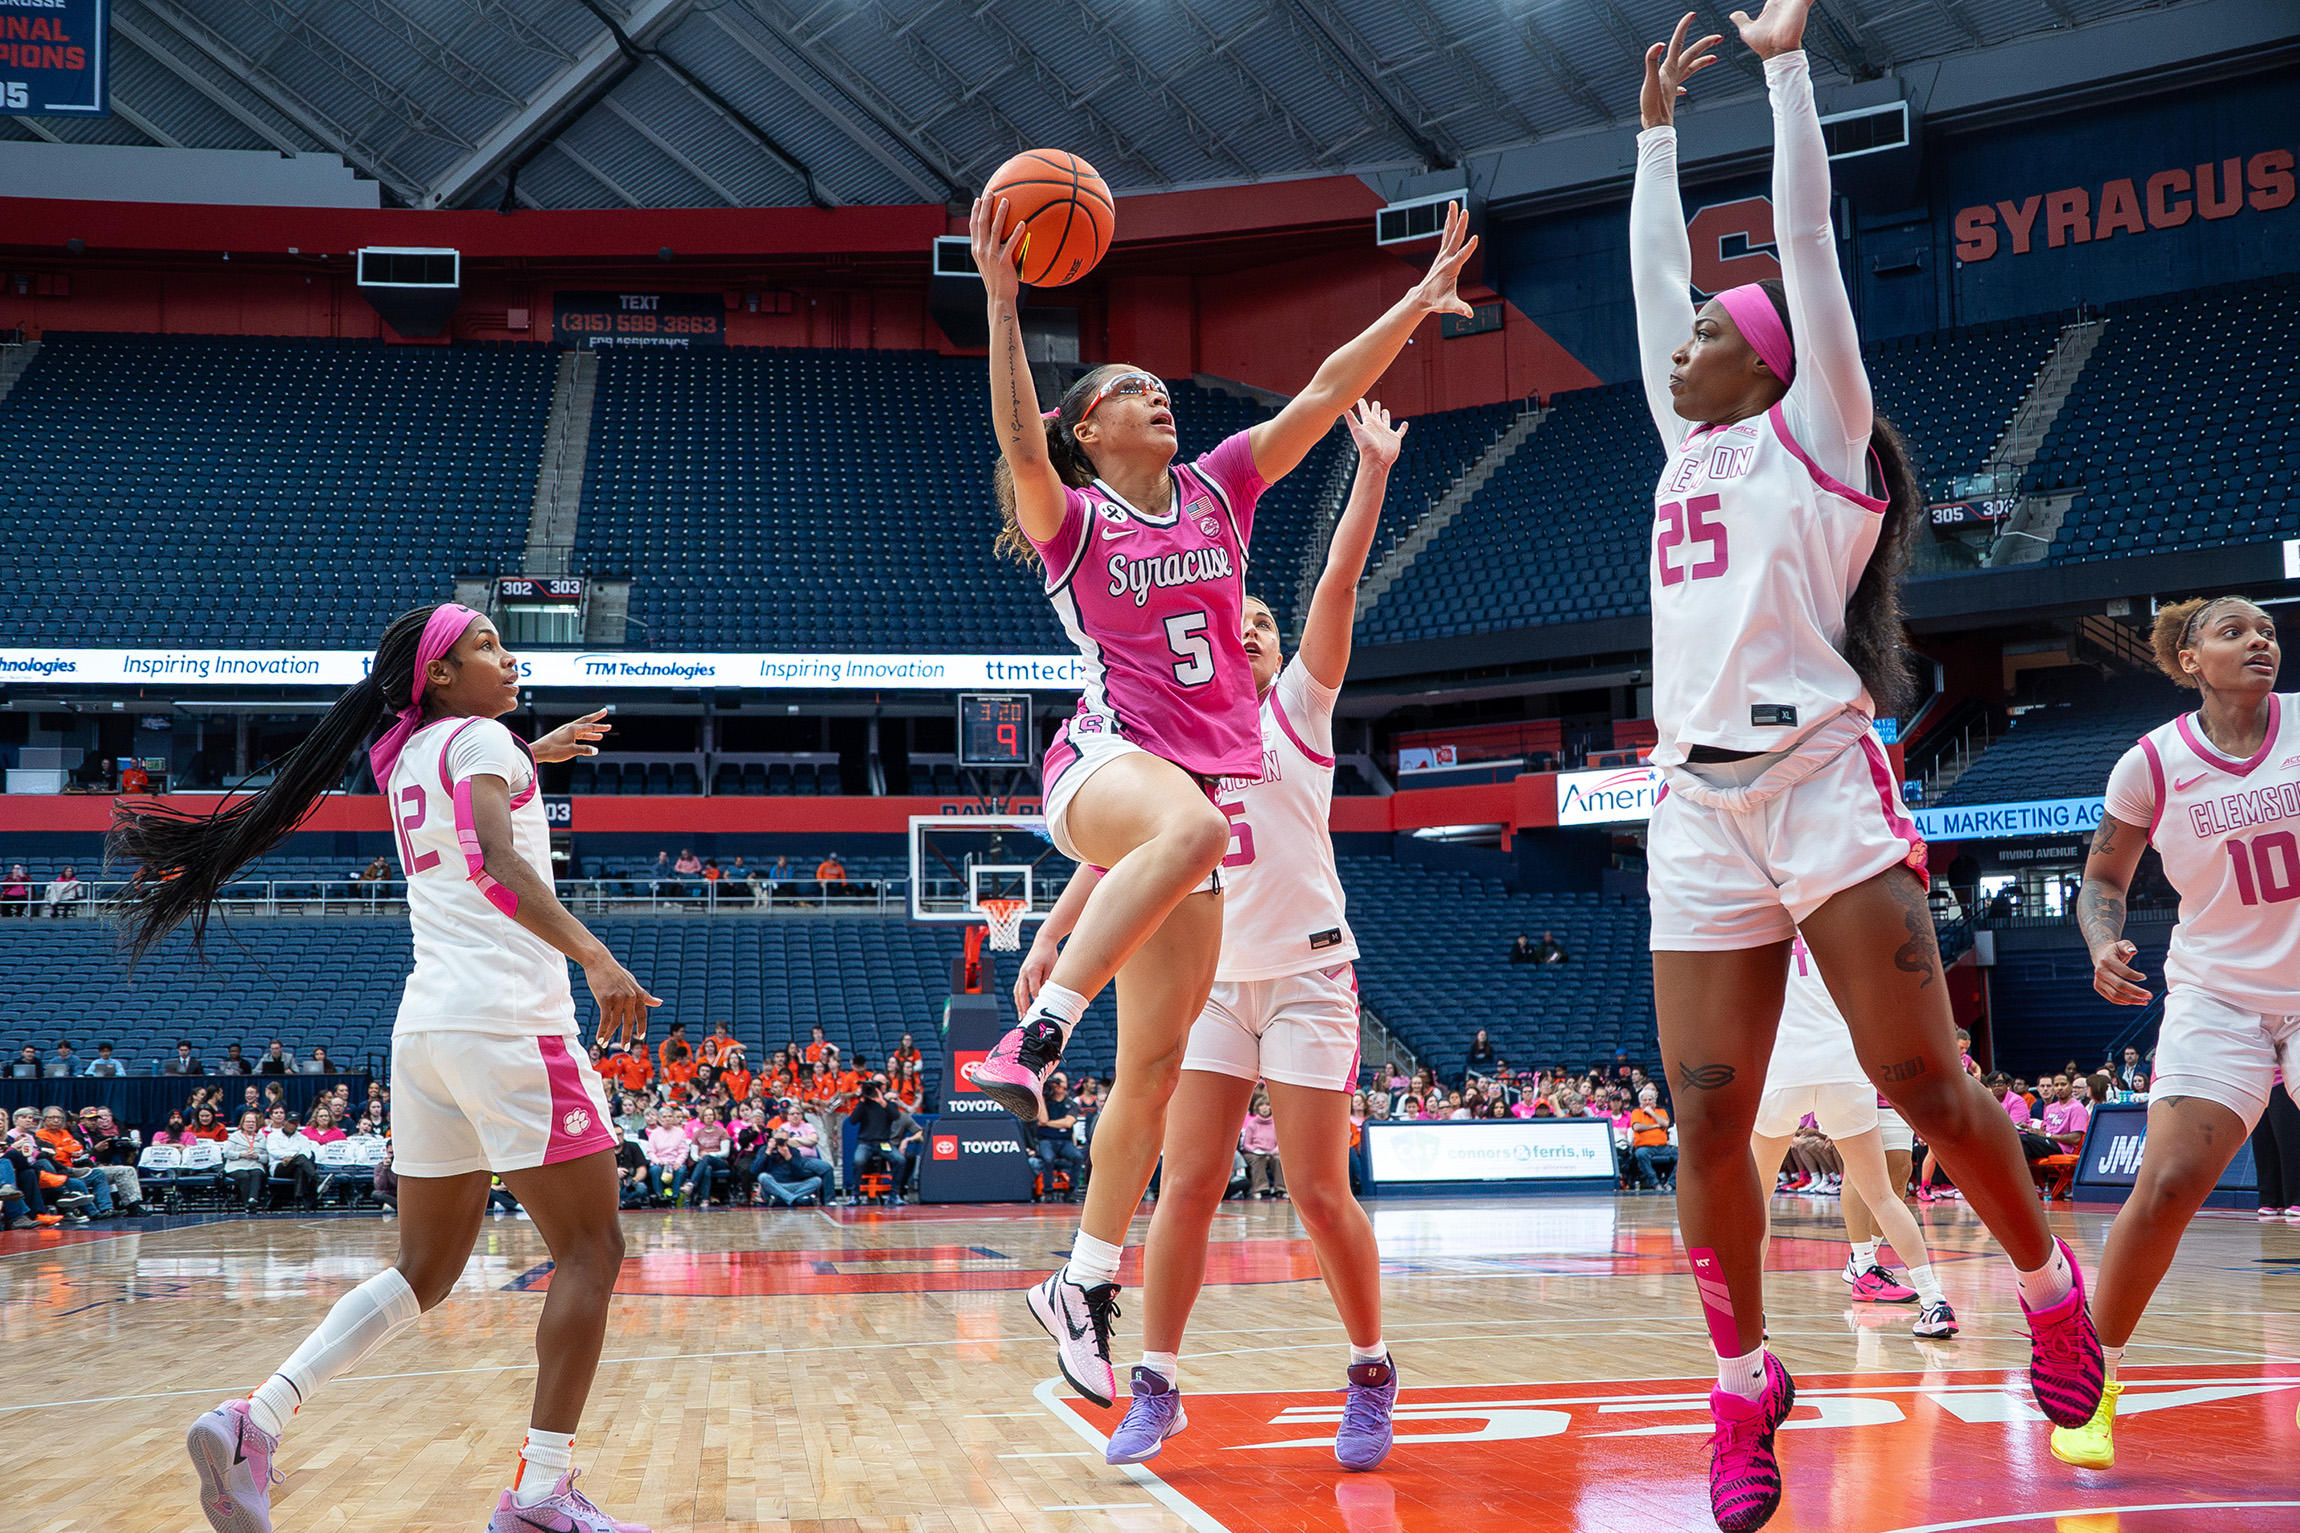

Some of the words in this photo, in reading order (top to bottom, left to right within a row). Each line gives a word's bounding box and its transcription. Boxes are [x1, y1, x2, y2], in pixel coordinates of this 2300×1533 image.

[0, 16, 70, 42] NAL
[619, 295, 660, 310] TEXT
[562, 313, 611, 331] (315)
[1932, 507, 1964, 524] 305
[1658, 493, 1729, 587] 25
[502, 582, 533, 595] 302
[550, 580, 580, 594] 303
[1108, 546, 1233, 608] Syracuse
[1164, 611, 1216, 687] 5
[123, 655, 210, 678] Inspiring
[215, 655, 320, 674] Innovation
[585, 662, 617, 676] TTM
[619, 663, 716, 680] Technologies
[759, 659, 841, 681] Inspiring
[846, 660, 945, 678] Innovation
[997, 724, 1016, 756] 9
[1561, 779, 1665, 813] Ameri
[1944, 806, 2070, 834] MARKETING
[2189, 781, 2300, 838] CLEMSO
[393, 784, 441, 877] 12
[2036, 846, 2078, 859] AVENUE
[2226, 831, 2300, 905] 10
[948, 1100, 1004, 1112] TOYOTA
[961, 1141, 1020, 1153] TOYOTA
[1448, 1147, 1511, 1160] connors
